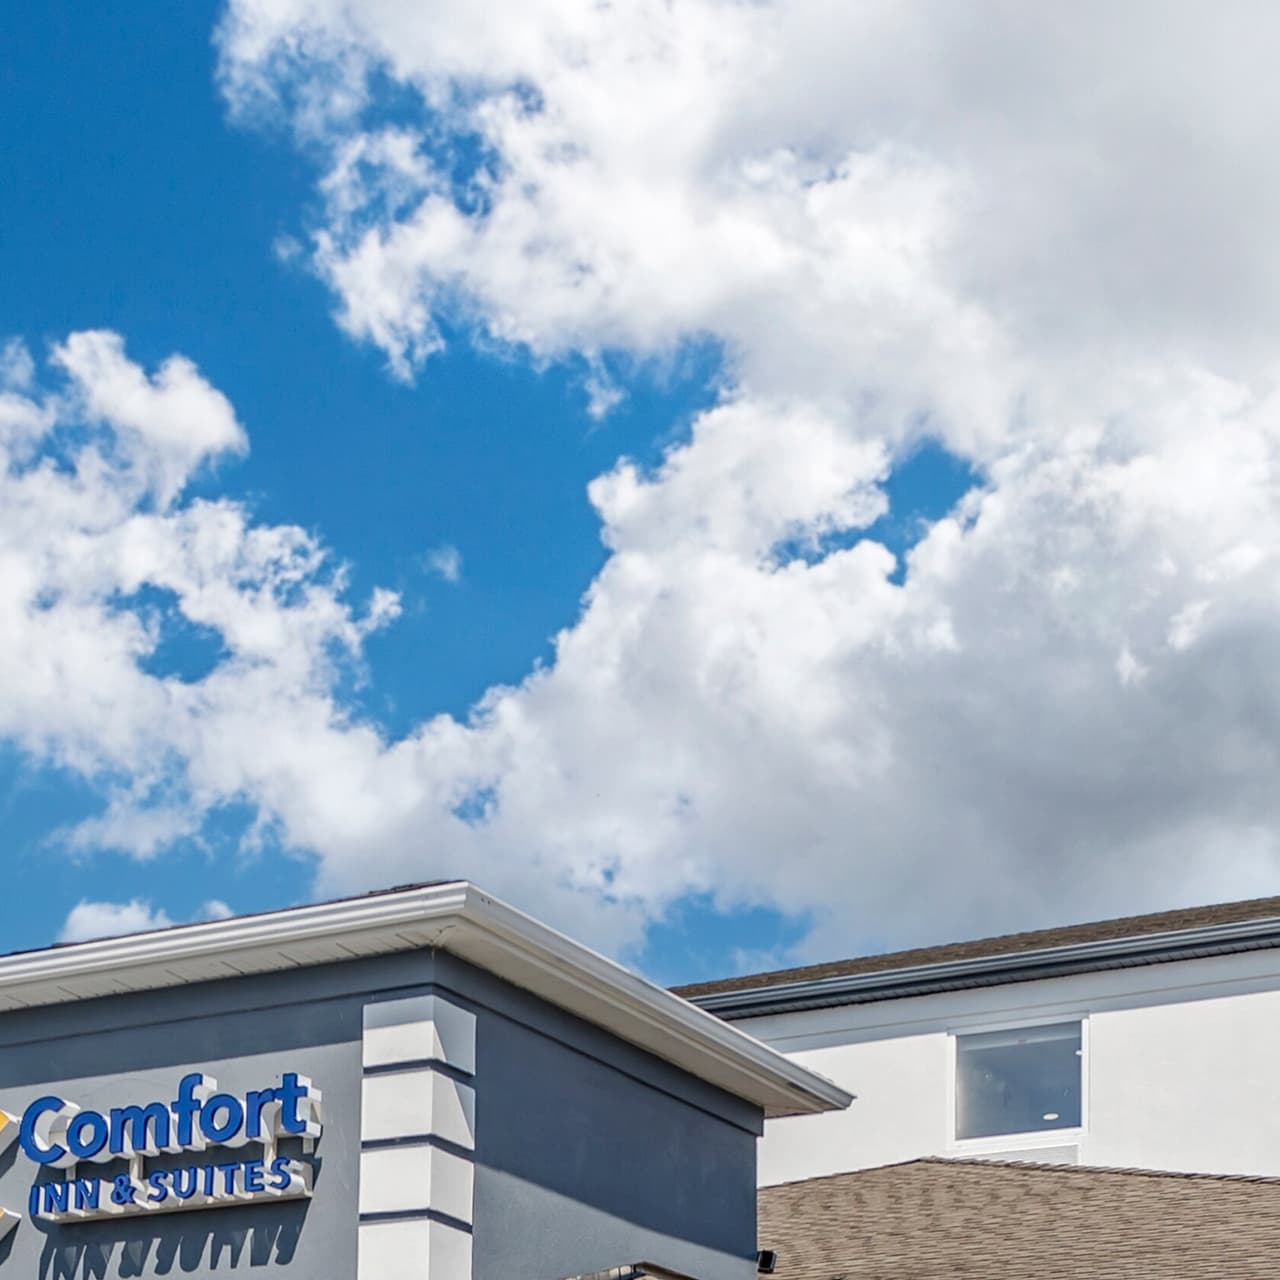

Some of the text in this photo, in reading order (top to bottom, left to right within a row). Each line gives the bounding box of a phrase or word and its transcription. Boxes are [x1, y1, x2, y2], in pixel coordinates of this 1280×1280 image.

[20, 1072, 310, 1165] Comfort
[29, 1156, 293, 1216] INN & SUITES
